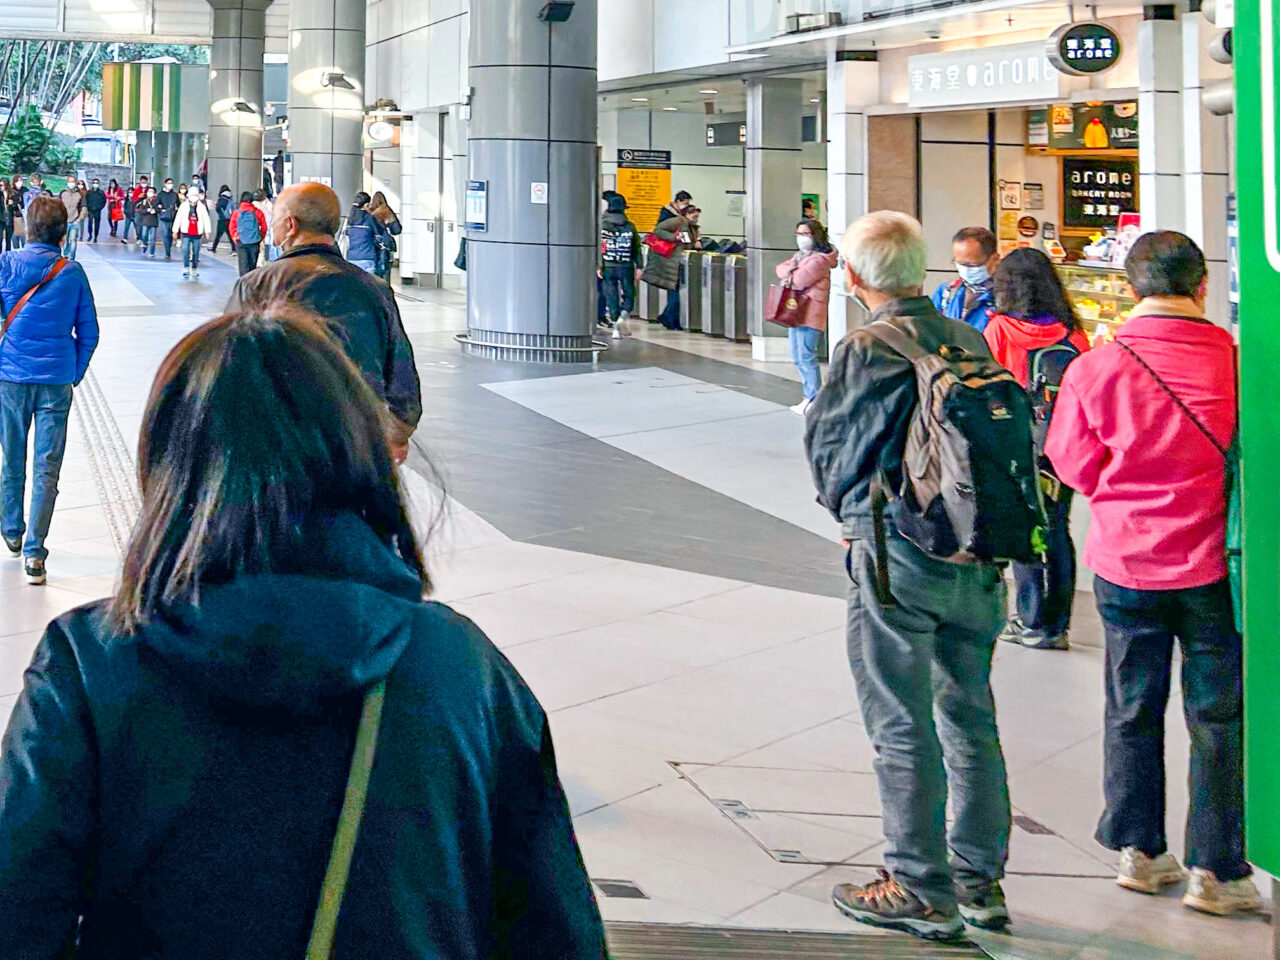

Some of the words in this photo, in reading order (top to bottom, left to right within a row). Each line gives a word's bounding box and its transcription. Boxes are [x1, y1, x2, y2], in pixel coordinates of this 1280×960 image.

[1066, 48, 1113, 59] arome
[910, 64, 961, 92] 東海堂
[1071, 171, 1132, 185] arome
